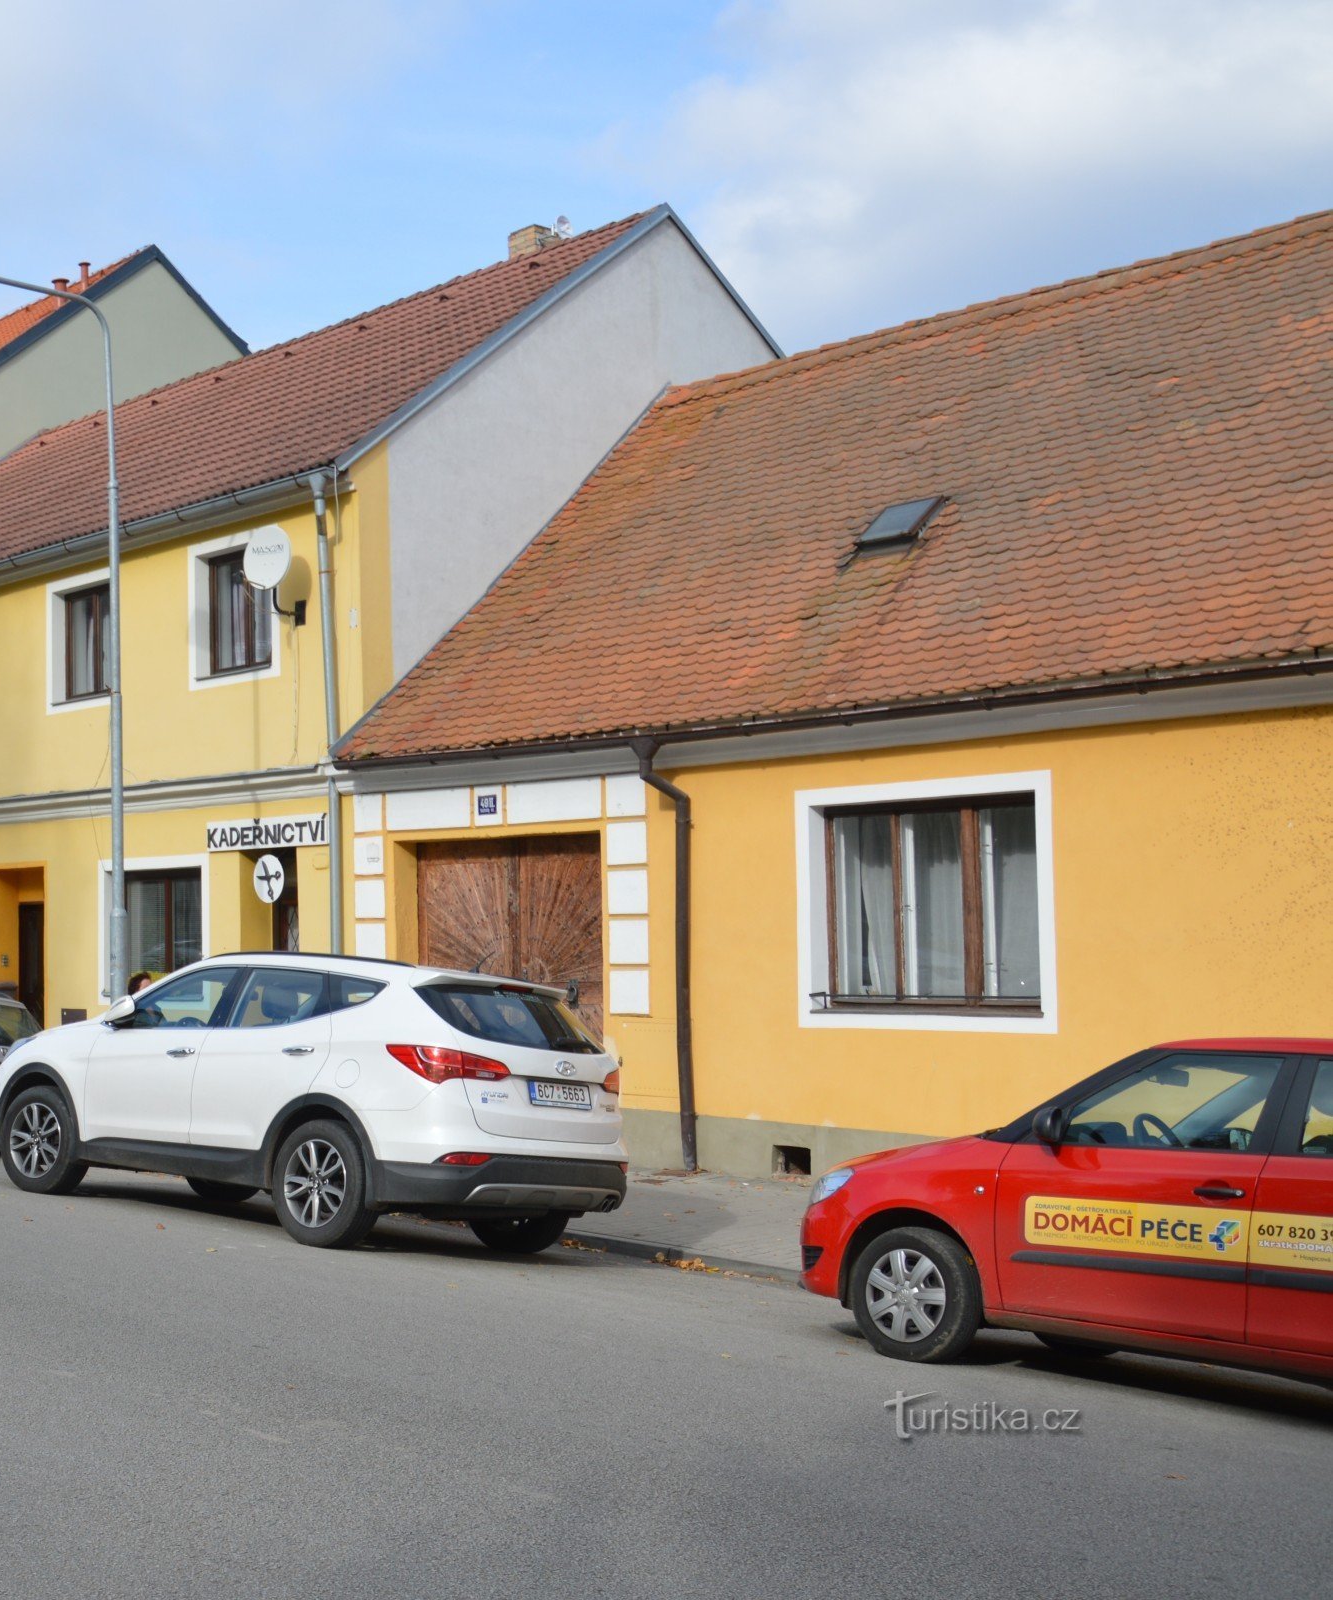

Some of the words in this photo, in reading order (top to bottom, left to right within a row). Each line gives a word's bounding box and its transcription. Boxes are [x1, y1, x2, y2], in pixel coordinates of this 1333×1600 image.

[207, 813, 327, 849] KADEŘNICTVÍ
[538, 1084, 555, 1099] 6C7
[562, 1086, 586, 1102] 5663
[1034, 1212, 1134, 1237] DOMÁCÍ
[1141, 1218, 1203, 1242] PÉČE
[1258, 1224, 1283, 1237] 607
[1289, 1226, 1316, 1240] 820
